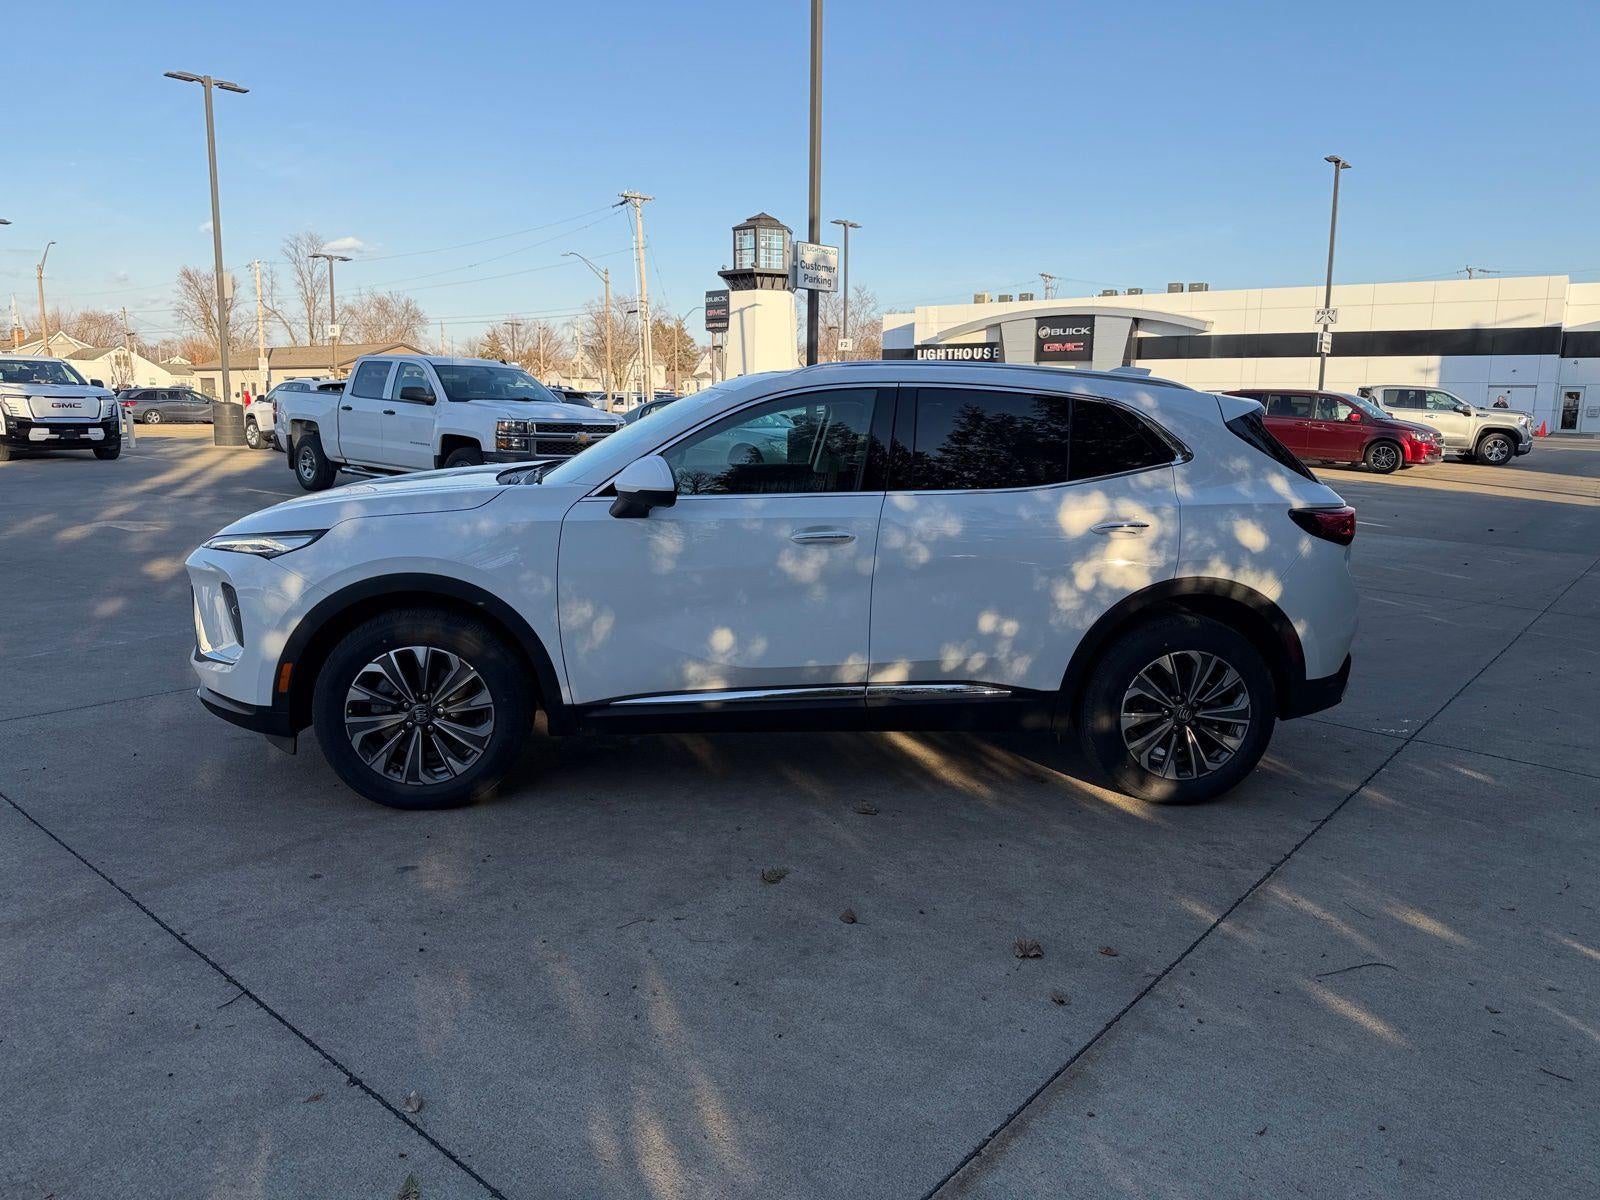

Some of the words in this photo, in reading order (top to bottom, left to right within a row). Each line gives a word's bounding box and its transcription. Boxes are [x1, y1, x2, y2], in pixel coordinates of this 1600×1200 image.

[800, 260, 836, 273] Customer
[804, 274, 832, 287] Parking
[1050, 326, 1091, 336] BUICK
[916, 347, 1000, 360] LIGHTHOUSE
[1043, 342, 1084, 352] GMC
